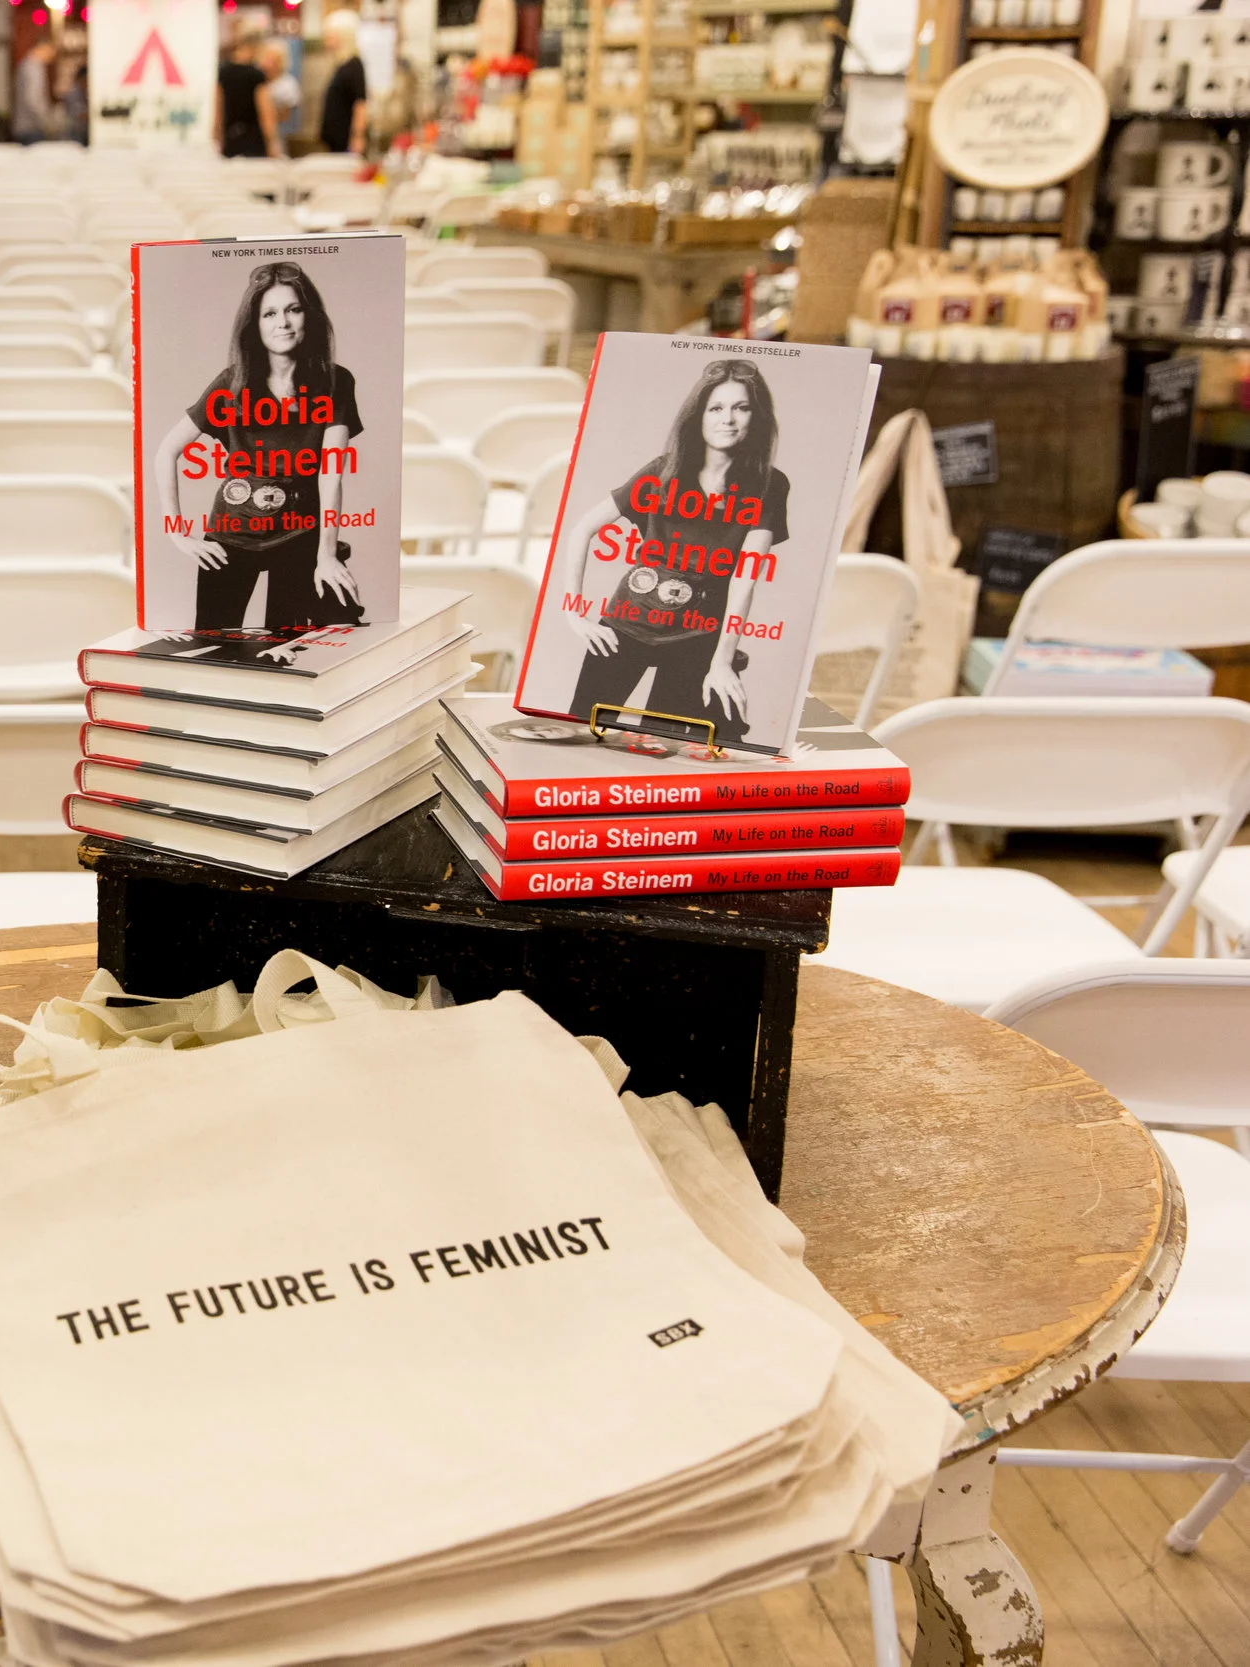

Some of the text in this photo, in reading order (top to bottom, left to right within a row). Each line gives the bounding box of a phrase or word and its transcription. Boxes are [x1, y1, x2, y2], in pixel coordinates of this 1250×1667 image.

[211, 245, 339, 258] NEW YORK TIMES BESTSELLER
[670, 340, 801, 358] NEW YORK TIMES BESTSELLER
[205, 386, 334, 428] Gloria
[181, 439, 358, 480] Steinem
[629, 474, 764, 527] Gloria
[164, 508, 375, 537] My Life on the Road
[592, 523, 777, 583] Steinem
[562, 592, 784, 640] My Life on the Road
[294, 638, 347, 648] Road
[534, 780, 860, 808] Gloria Steinem My Life on the Road
[532, 824, 854, 852] Gloria Steinem My Life on the Road
[528, 867, 849, 893] Gloria Steinem My Life on the Road
[57, 1216, 612, 1346] THE FUTURE IS FEMINIST
[652, 1320, 698, 1346] SBX
